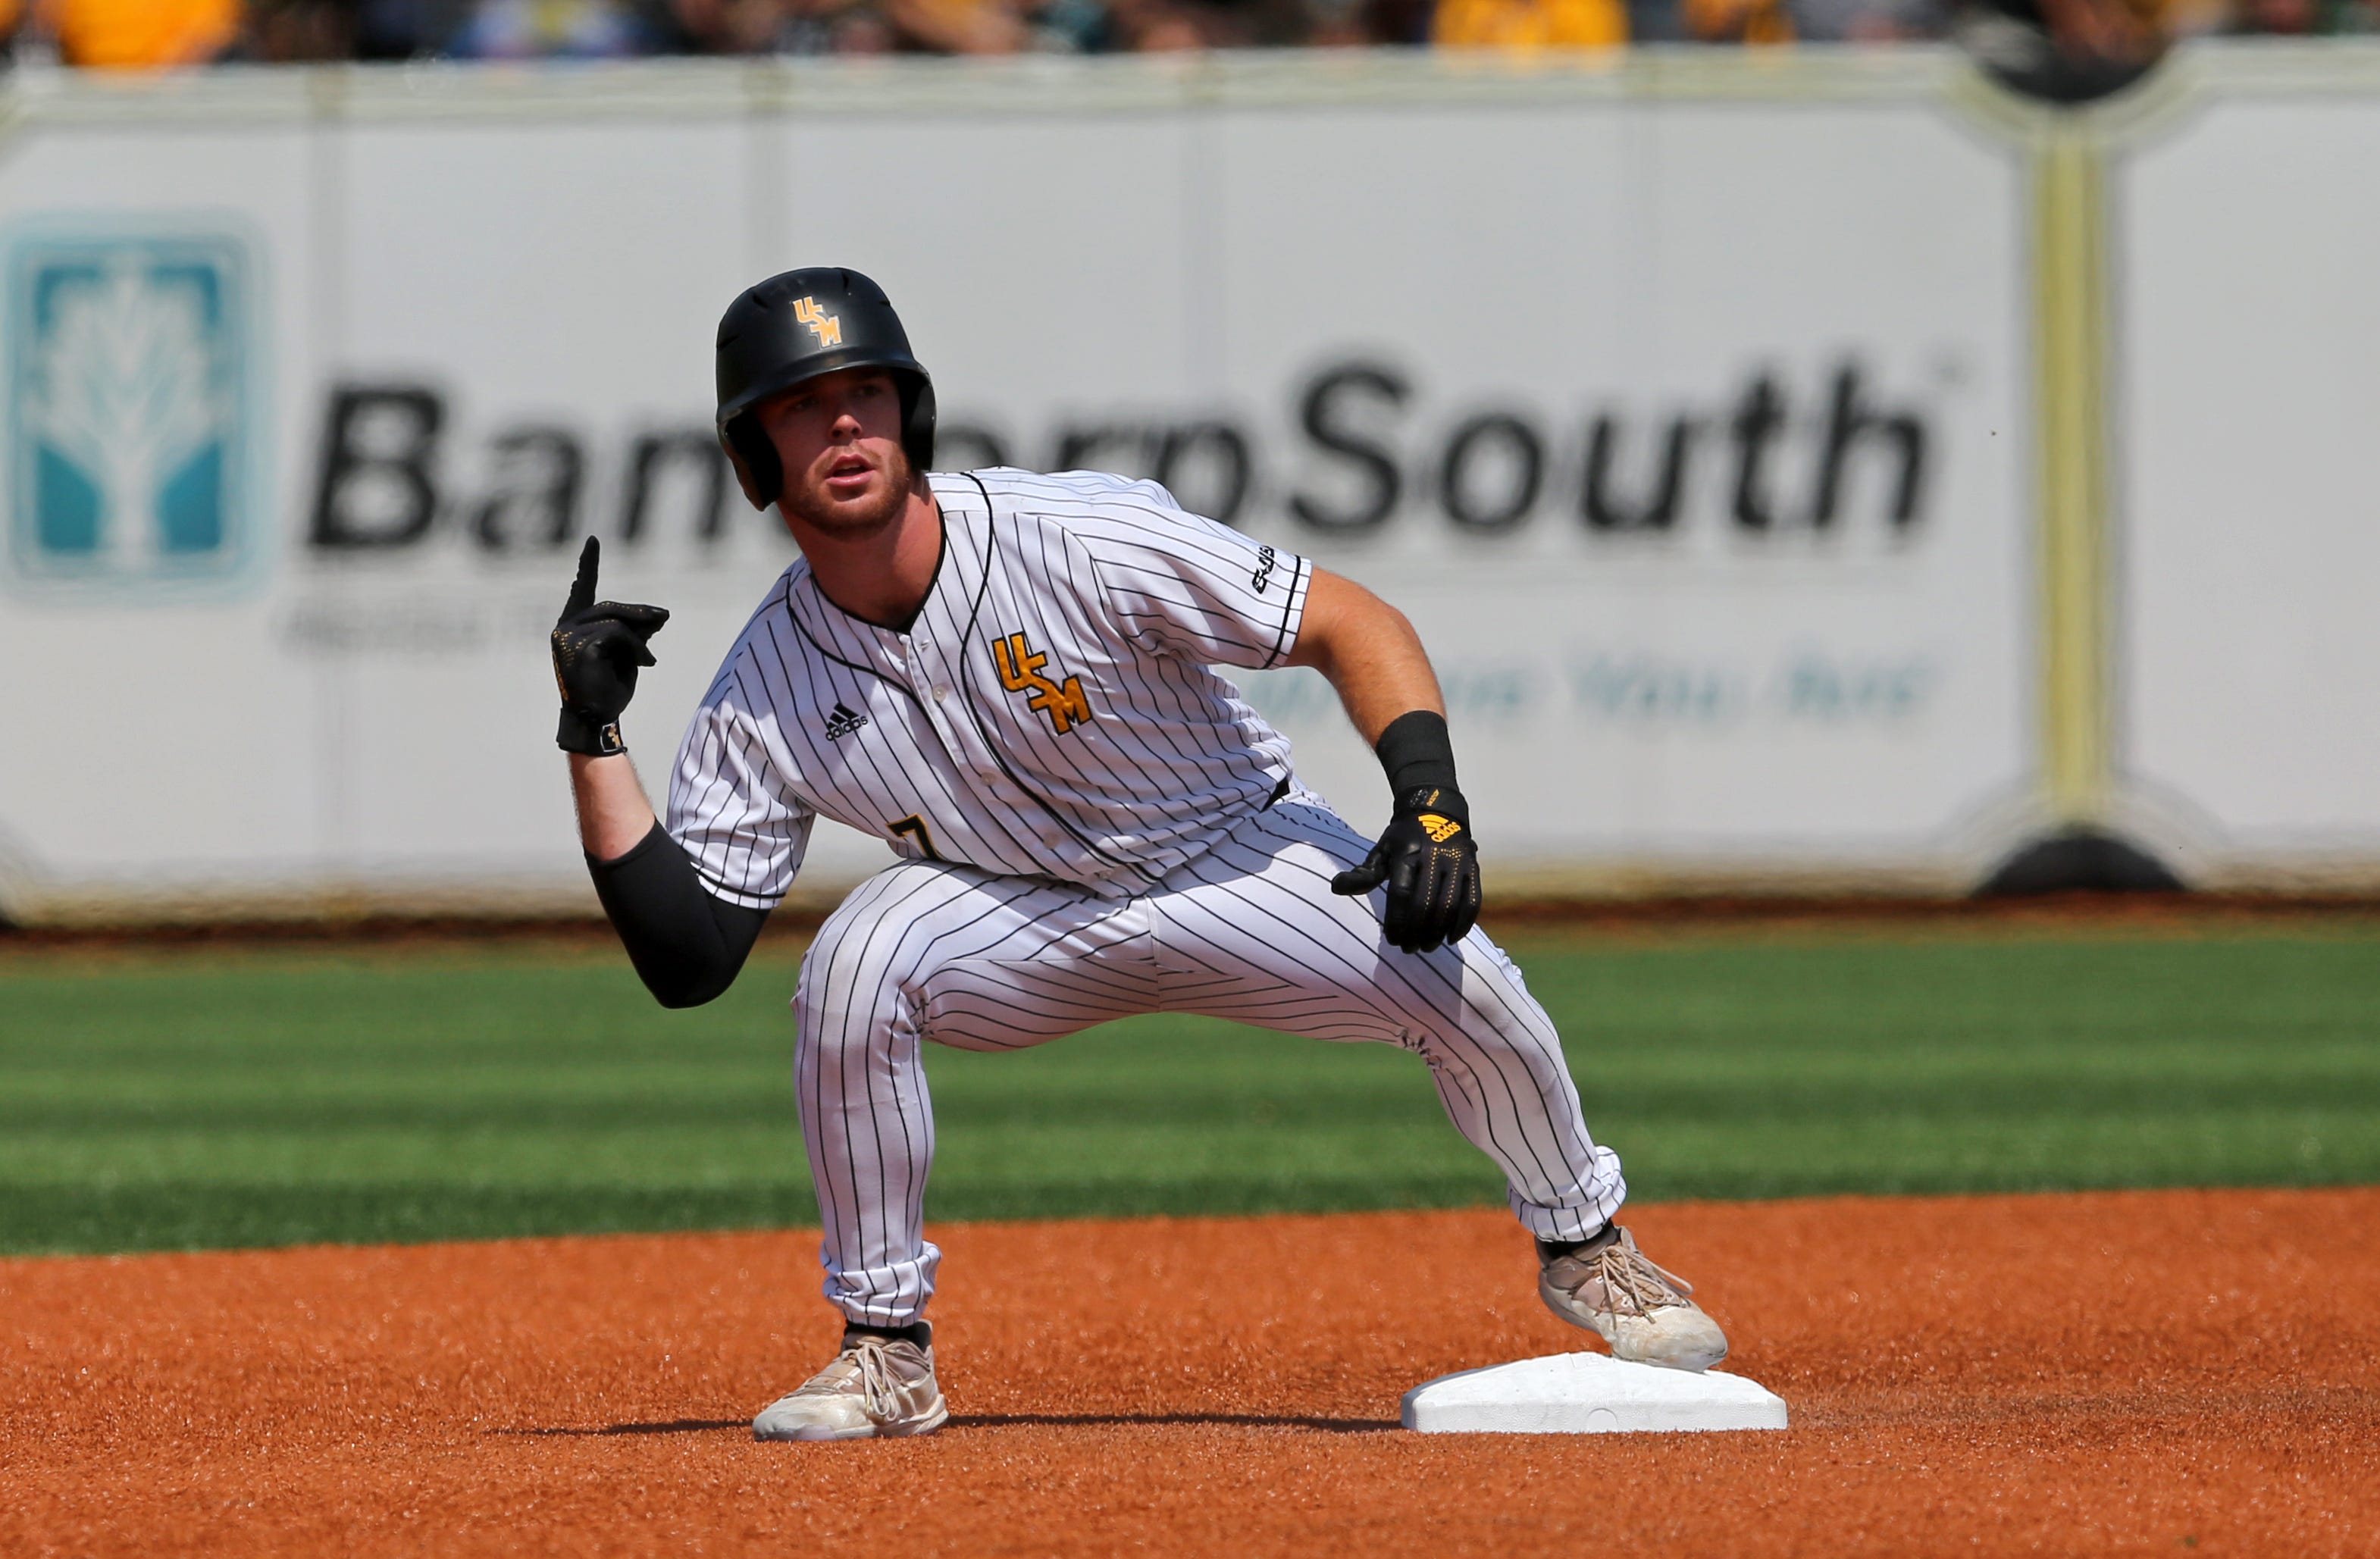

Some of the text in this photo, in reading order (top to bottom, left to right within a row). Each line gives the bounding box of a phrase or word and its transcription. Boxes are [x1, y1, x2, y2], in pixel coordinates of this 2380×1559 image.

[309, 359, 1931, 547] BanrpSouth
[991, 631, 1093, 737] USM
[825, 715, 869, 741] adidas
[1430, 822, 1461, 843] adidas
